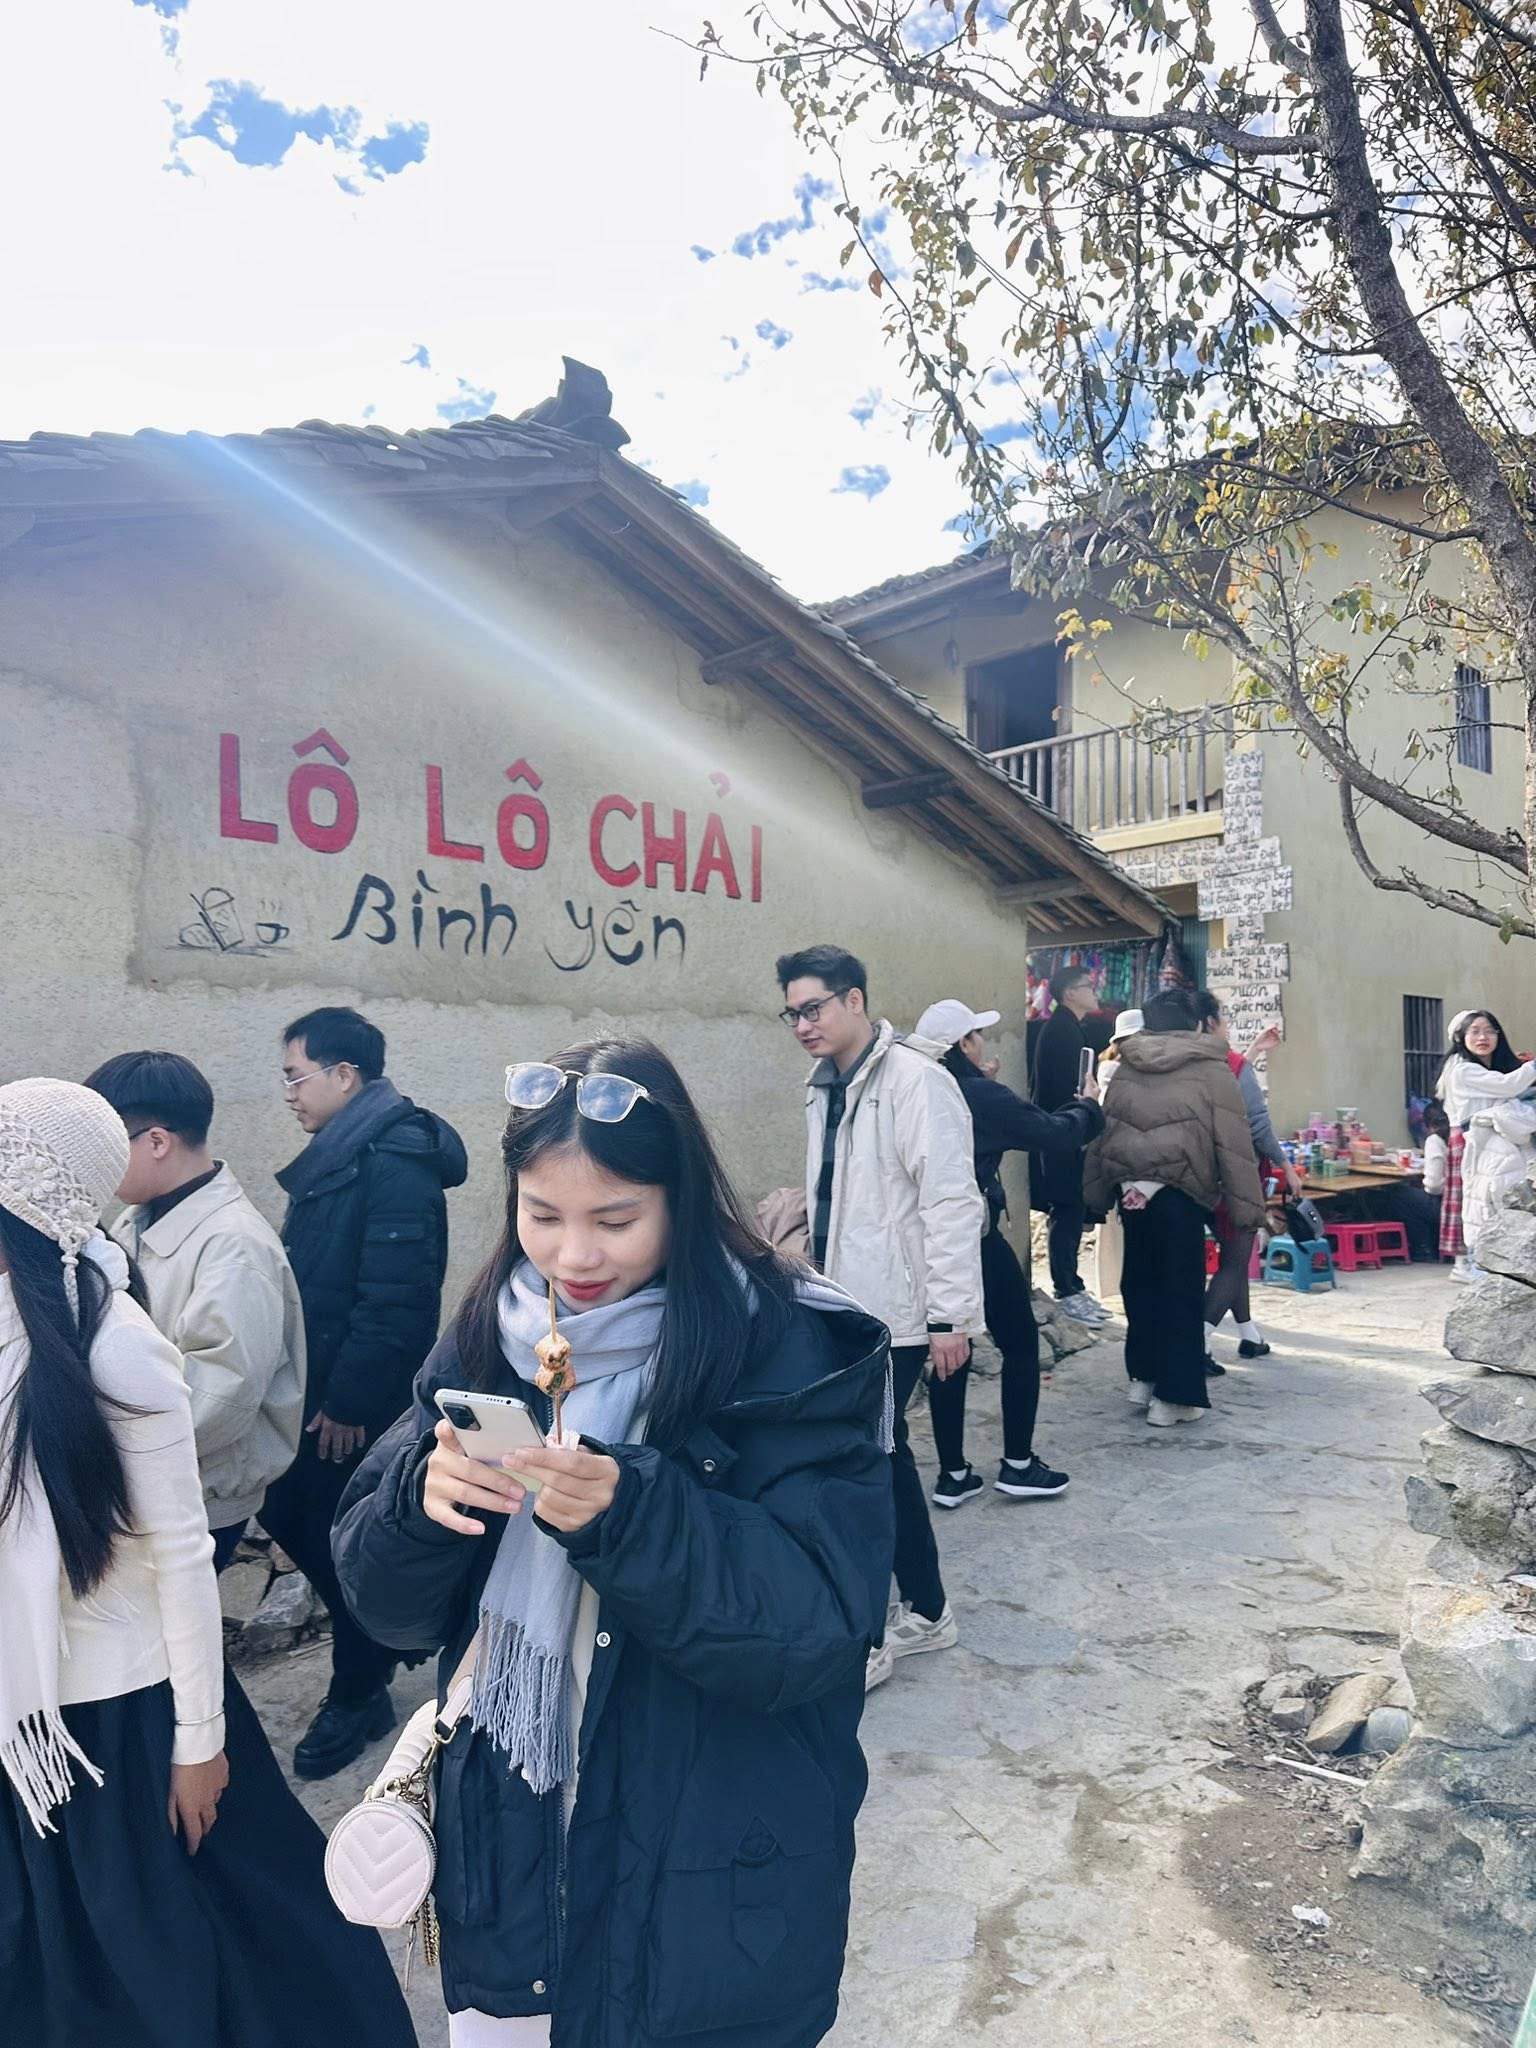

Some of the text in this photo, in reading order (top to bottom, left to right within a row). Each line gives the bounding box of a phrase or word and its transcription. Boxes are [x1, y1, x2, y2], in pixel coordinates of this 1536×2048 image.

[219, 727, 763, 904] LÔ LÔ CHẢI
[331, 869, 518, 957] Bình
